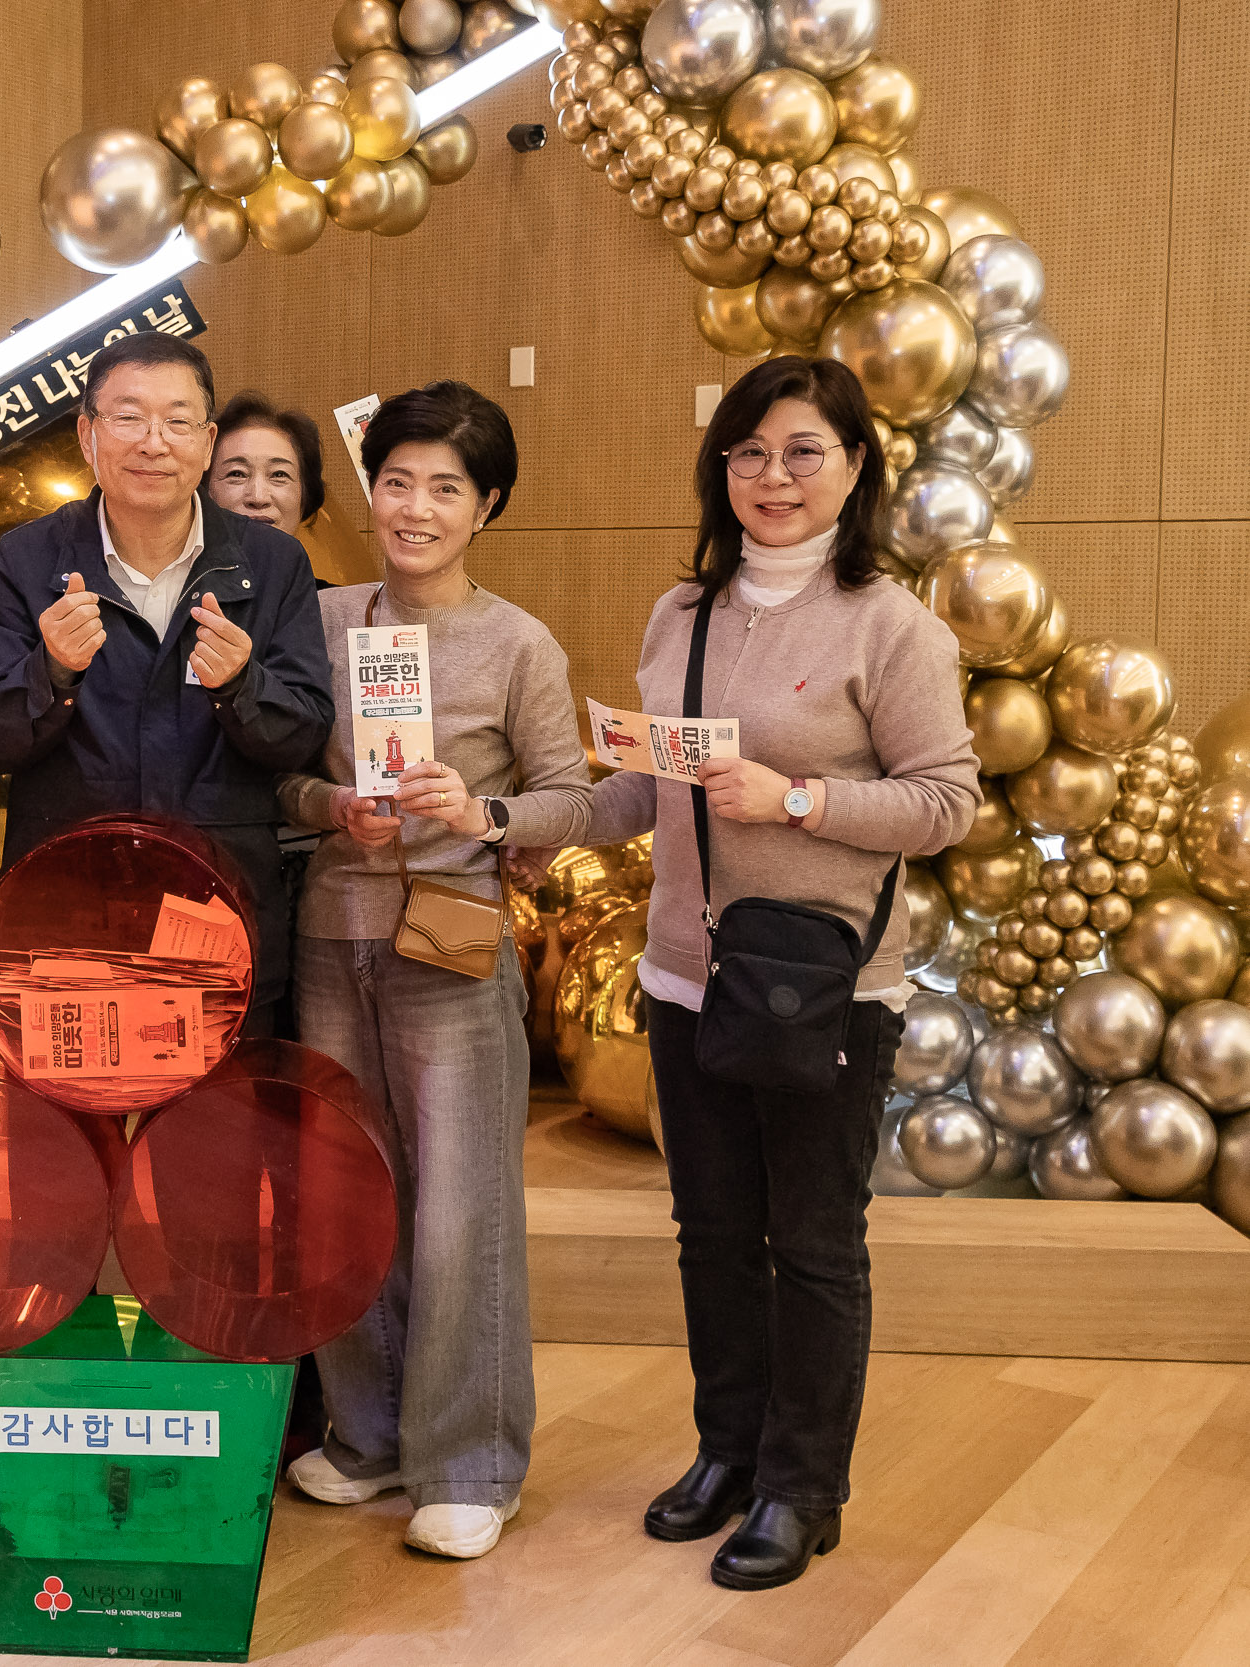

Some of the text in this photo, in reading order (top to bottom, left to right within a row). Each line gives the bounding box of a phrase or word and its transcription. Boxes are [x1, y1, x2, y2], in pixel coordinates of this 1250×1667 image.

[142, 293, 193, 338] 날
[359, 652, 419, 664] 2026 희망온돌
[359, 663, 420, 683] 따뜻한
[360, 682, 420, 697] 겨울나기
[668, 725, 688, 776] 겨울나기
[701, 728, 710, 750] 2026
[61, 1001, 82, 1068] 따뜻한
[82, 1002, 98, 1066] 겨울나기
[52, 1044, 61, 1067] 2026
